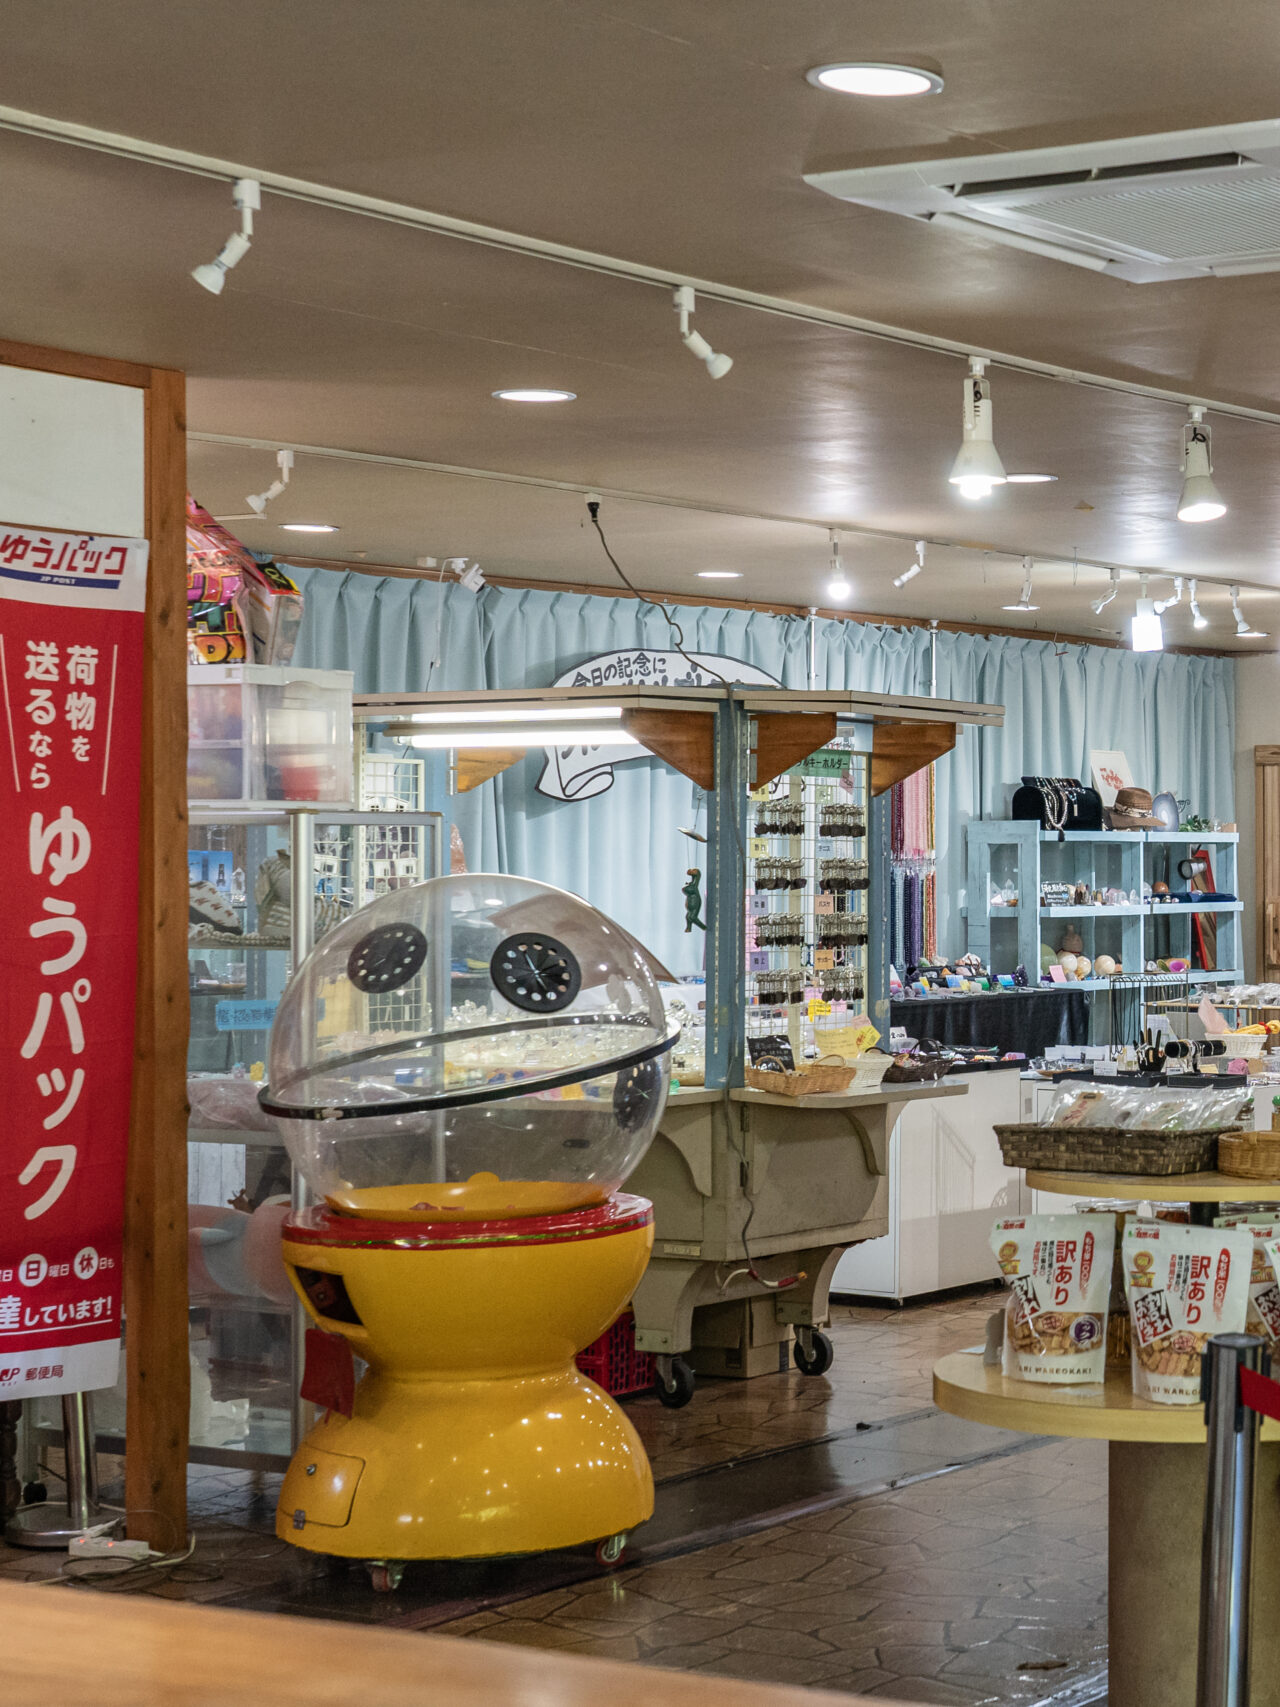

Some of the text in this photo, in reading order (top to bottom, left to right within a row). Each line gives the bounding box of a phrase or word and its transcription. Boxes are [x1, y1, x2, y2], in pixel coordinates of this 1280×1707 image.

[0, 534, 128, 575] ゆうパック
[65, 644, 99, 762] 荷物を
[571, 651, 668, 688] 今日の記念に
[25, 640, 60, 790] 送るなら
[19, 805, 93, 1221] ゆうパック
[1054, 1240, 1077, 1306] 訳あり
[1186, 1255, 1212, 1325] 訳あり
[25, 1364, 64, 1382] 郵便局
